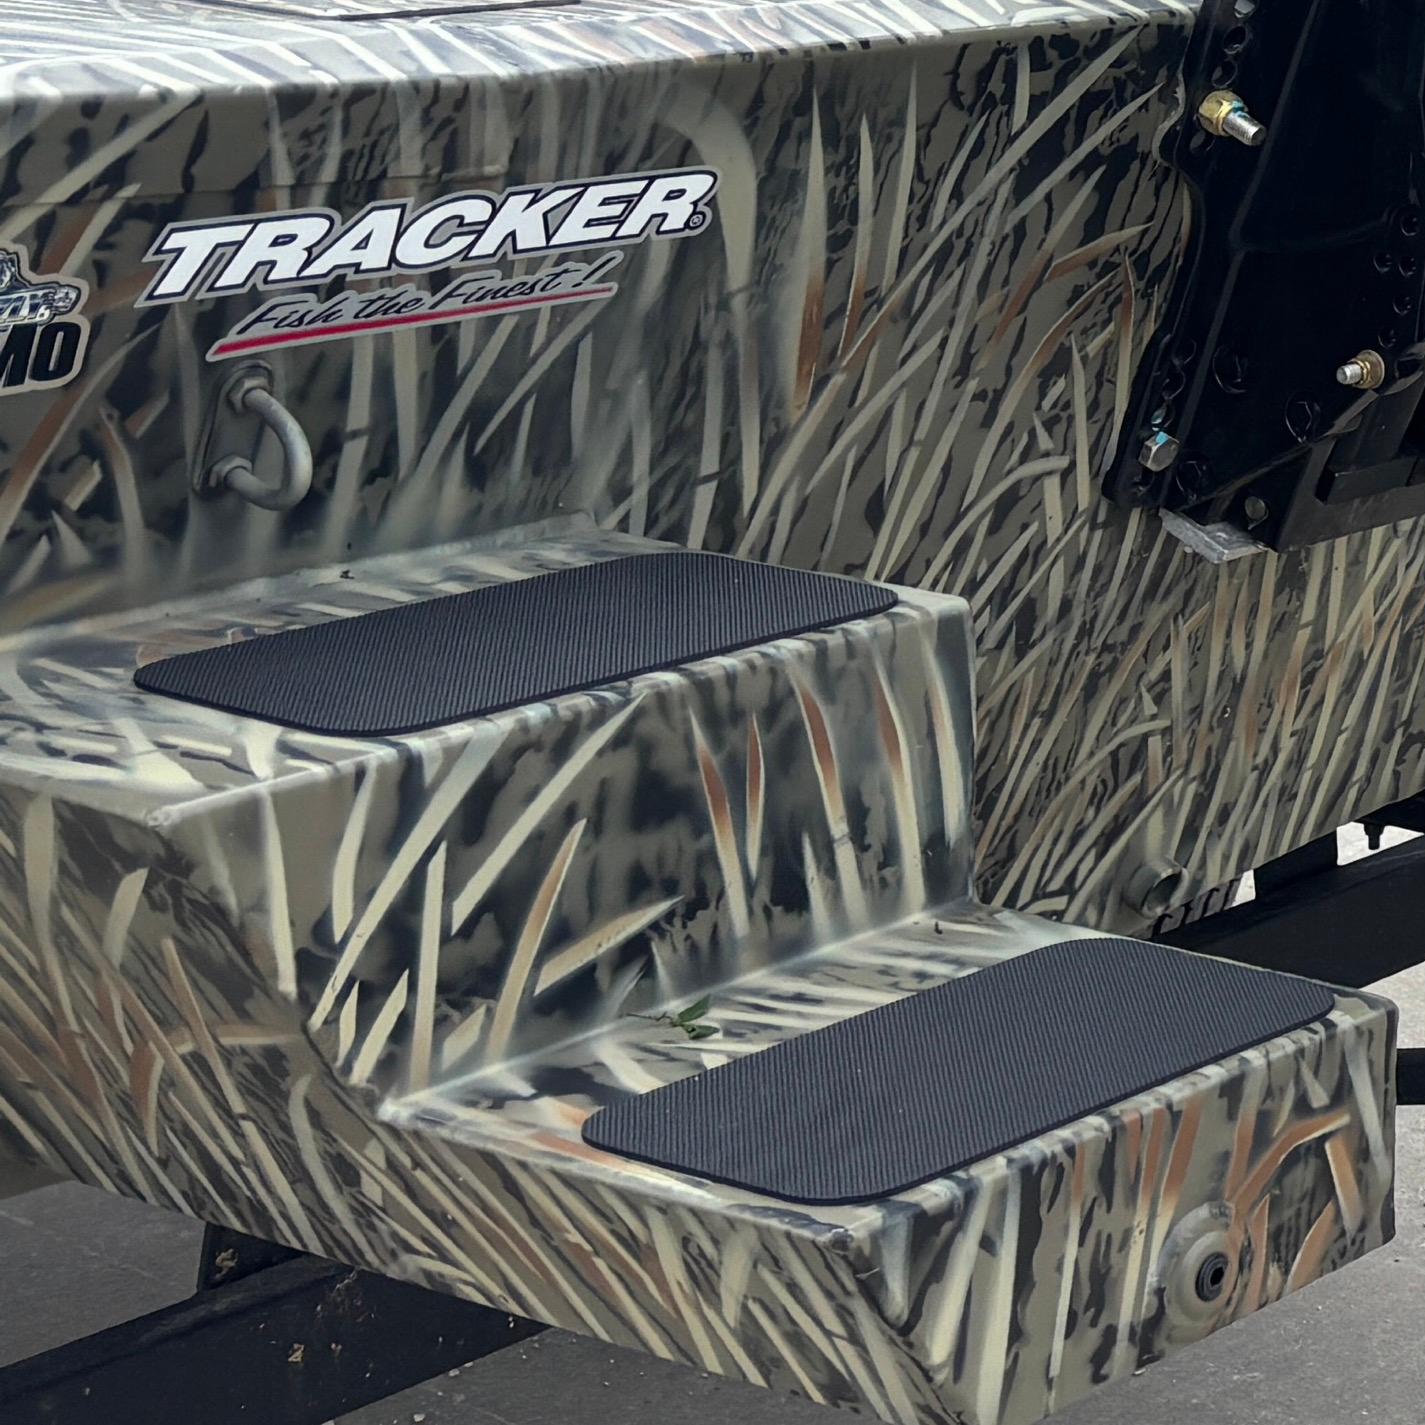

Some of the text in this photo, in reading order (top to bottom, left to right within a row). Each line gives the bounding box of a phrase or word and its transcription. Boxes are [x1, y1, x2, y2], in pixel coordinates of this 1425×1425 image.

[150, 173, 717, 298] TRACKER
[236, 296, 346, 336] Fish
[352, 287, 425, 322] the
